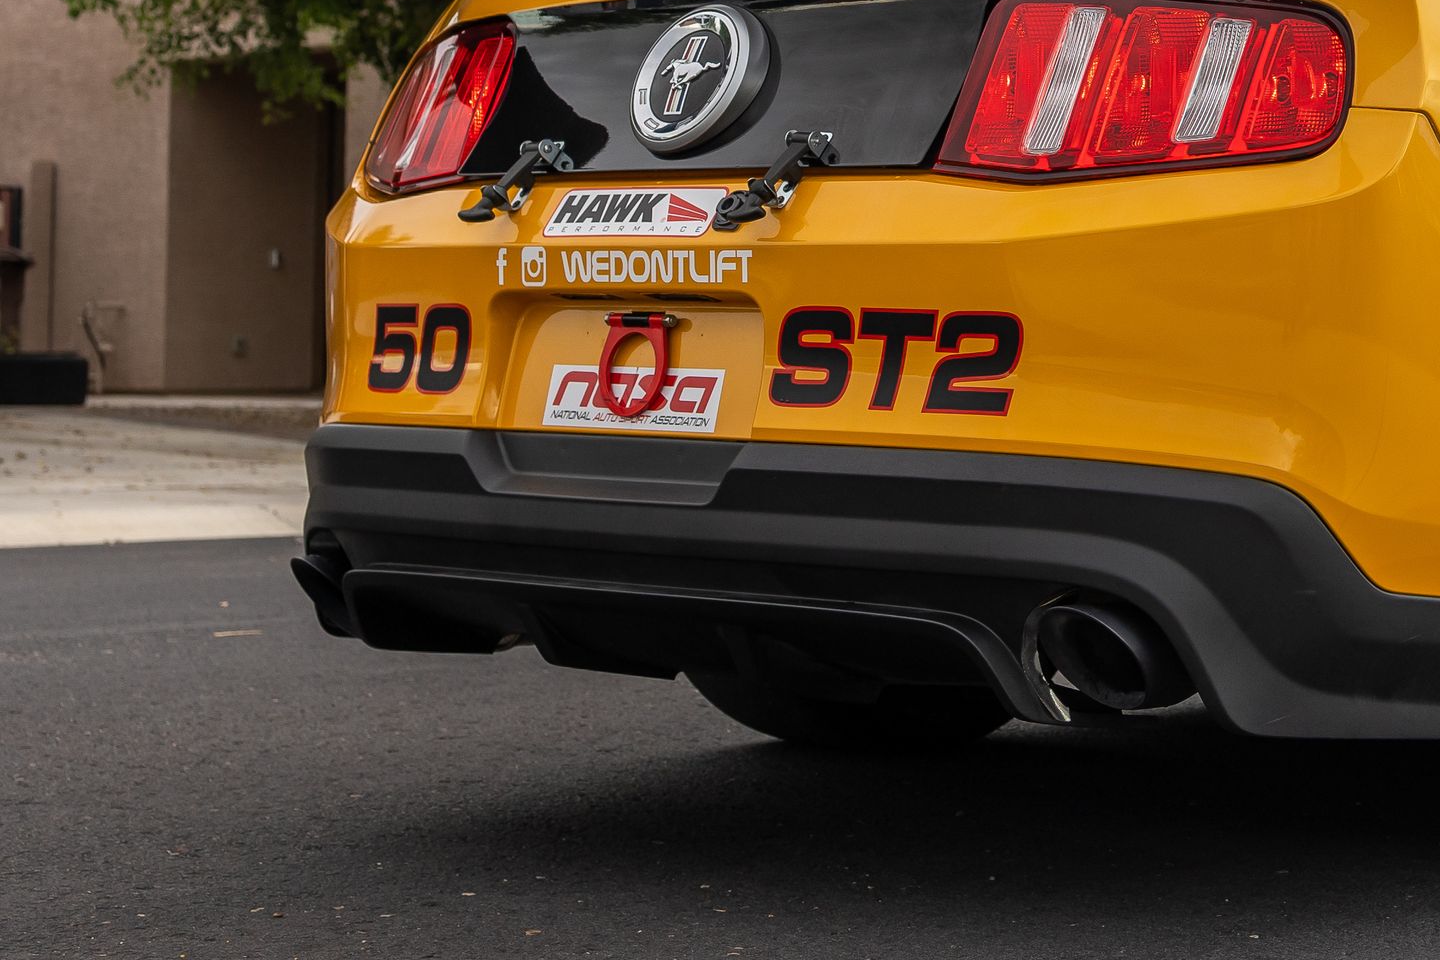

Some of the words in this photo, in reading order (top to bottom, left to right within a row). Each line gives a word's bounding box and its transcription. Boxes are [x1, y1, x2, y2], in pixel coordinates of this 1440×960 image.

[553, 193, 669, 224] HAWK
[547, 225, 703, 234] PERFORMANCE
[560, 249, 753, 283] WEDONTLIFT
[368, 304, 473, 395] 50
[769, 306, 1024, 416] ST2
[550, 409, 591, 421] NATIONAL
[592, 412, 618, 422] AUTO
[618, 414, 650, 424] SPORT
[650, 415, 711, 427] ASSOCIATION
